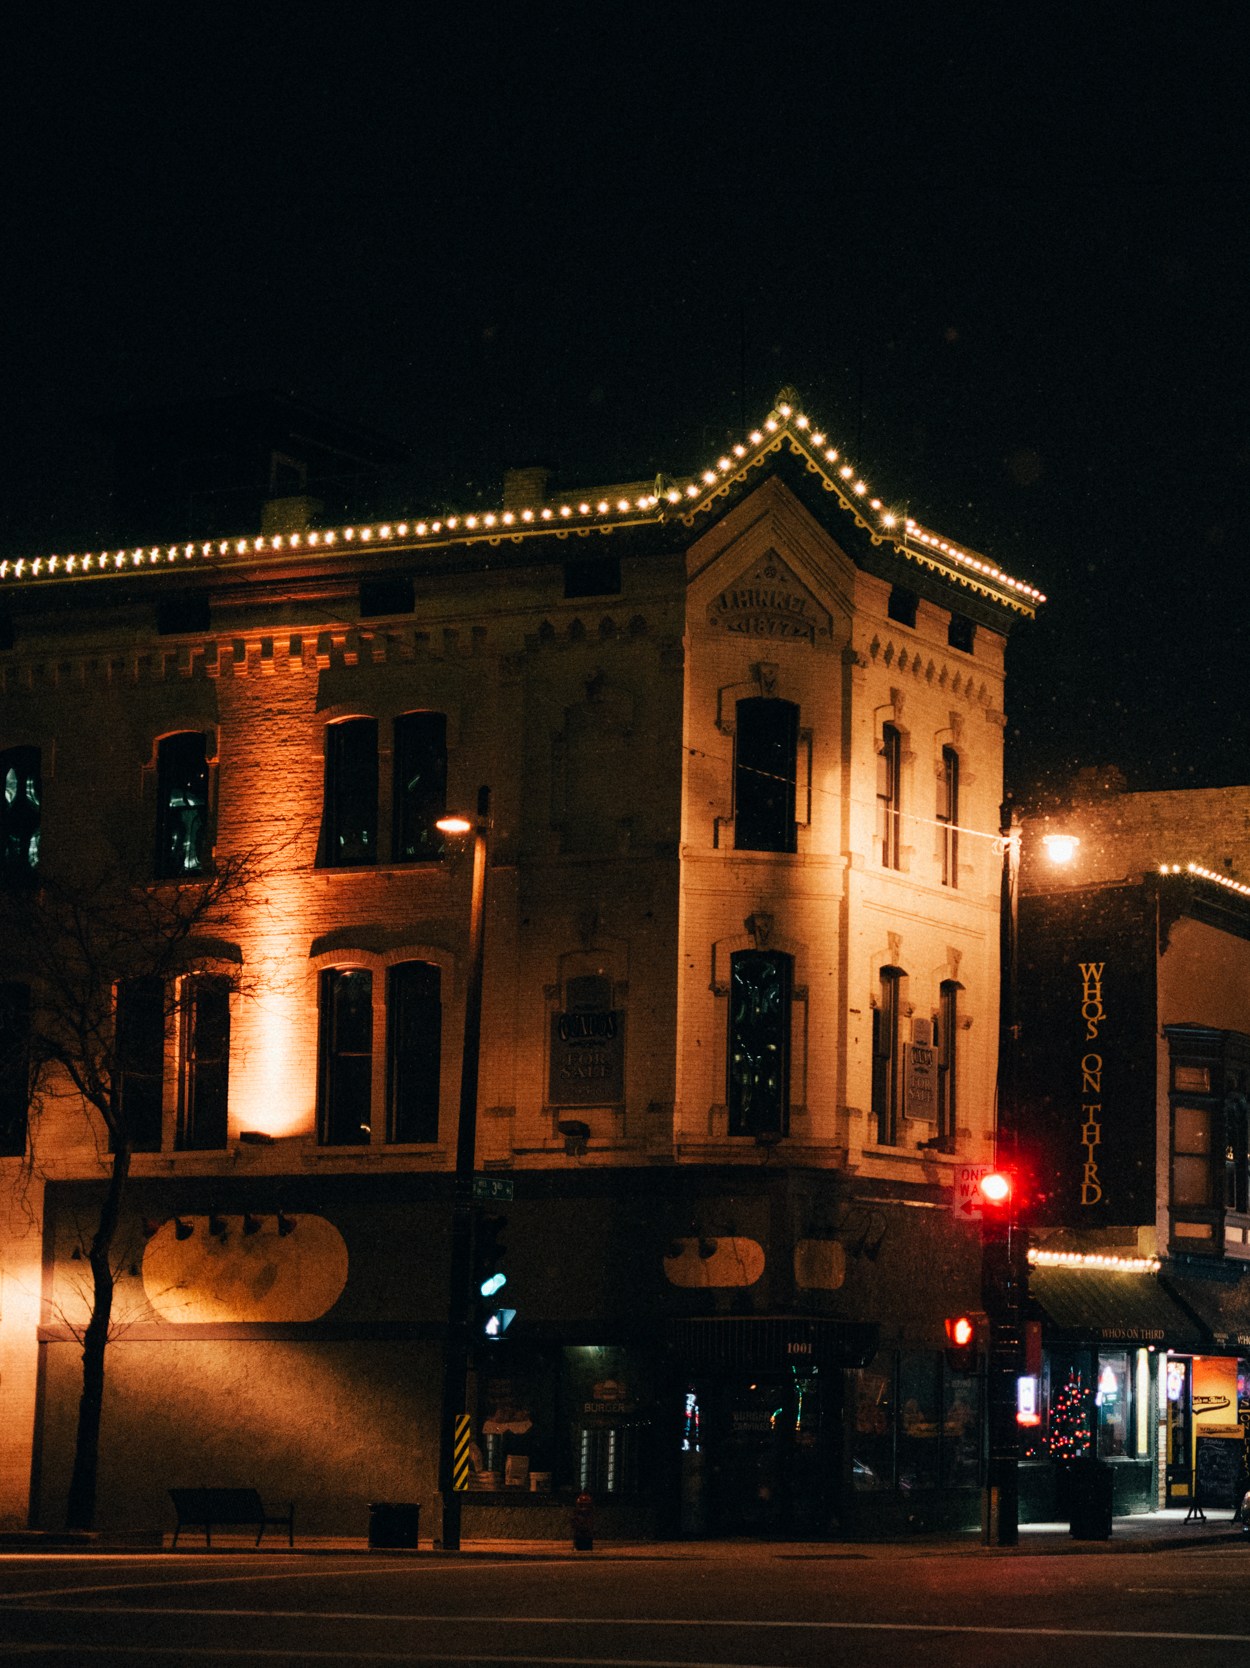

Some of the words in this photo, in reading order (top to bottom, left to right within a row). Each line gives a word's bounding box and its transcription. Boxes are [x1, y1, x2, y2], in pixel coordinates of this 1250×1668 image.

[1079, 962, 1107, 1040] WHO'S
[566, 1052, 607, 1065] FOR
[560, 1064, 613, 1079] SALE
[1081, 1053, 1103, 1093] ON
[911, 1074, 932, 1090] FOR
[1081, 1104, 1103, 1205] THIRD
[1126, 1329, 1139, 1338] ON
[1140, 1329, 1165, 1340] THIRD
[786, 1341, 813, 1355] 1001
